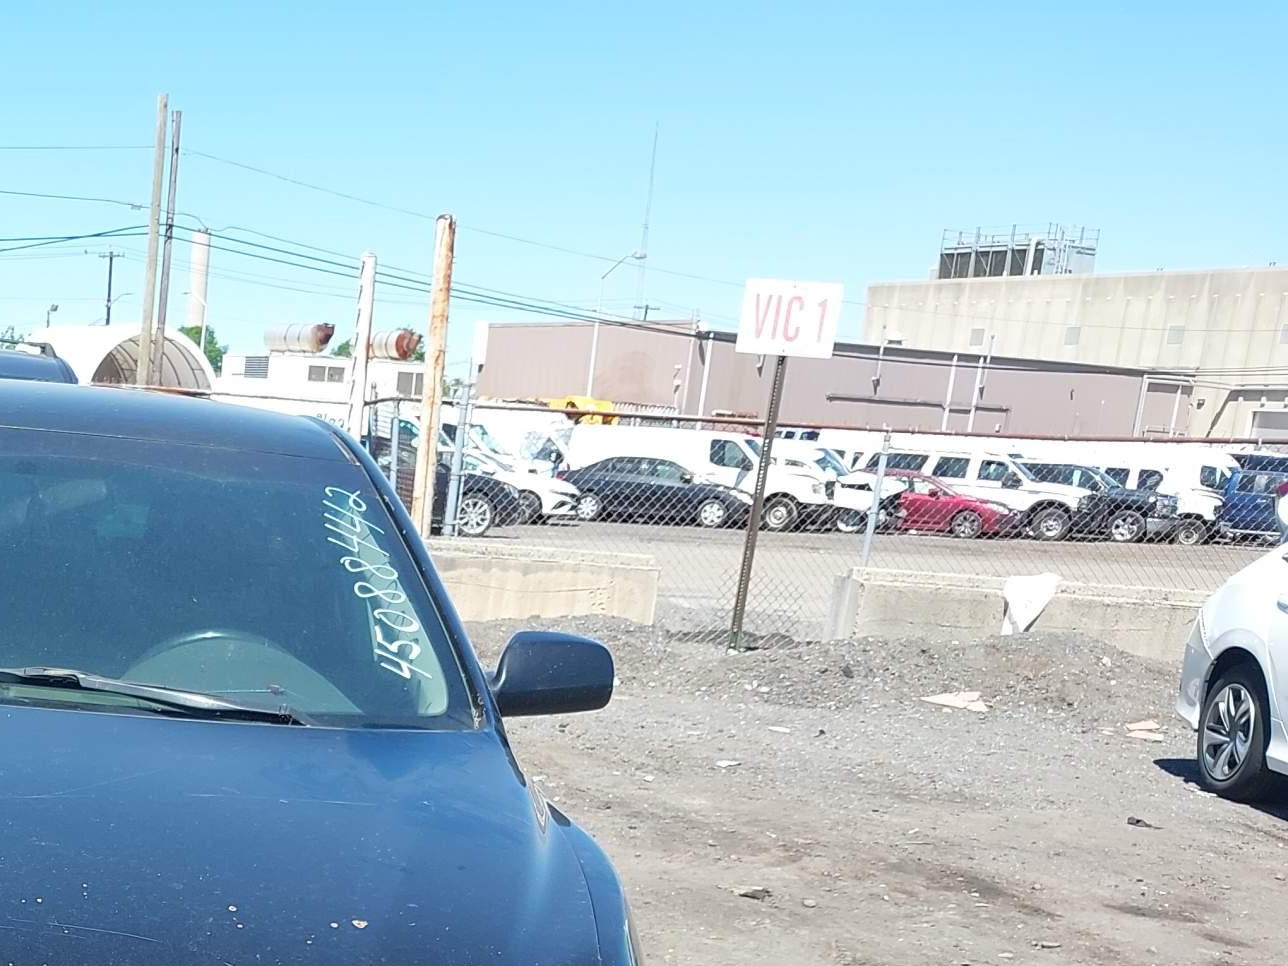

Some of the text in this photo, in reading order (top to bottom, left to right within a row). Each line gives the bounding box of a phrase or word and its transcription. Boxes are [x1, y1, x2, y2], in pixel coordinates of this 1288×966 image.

[754, 293, 829, 343] VIC 1
[323, 486, 433, 679] 45088442
